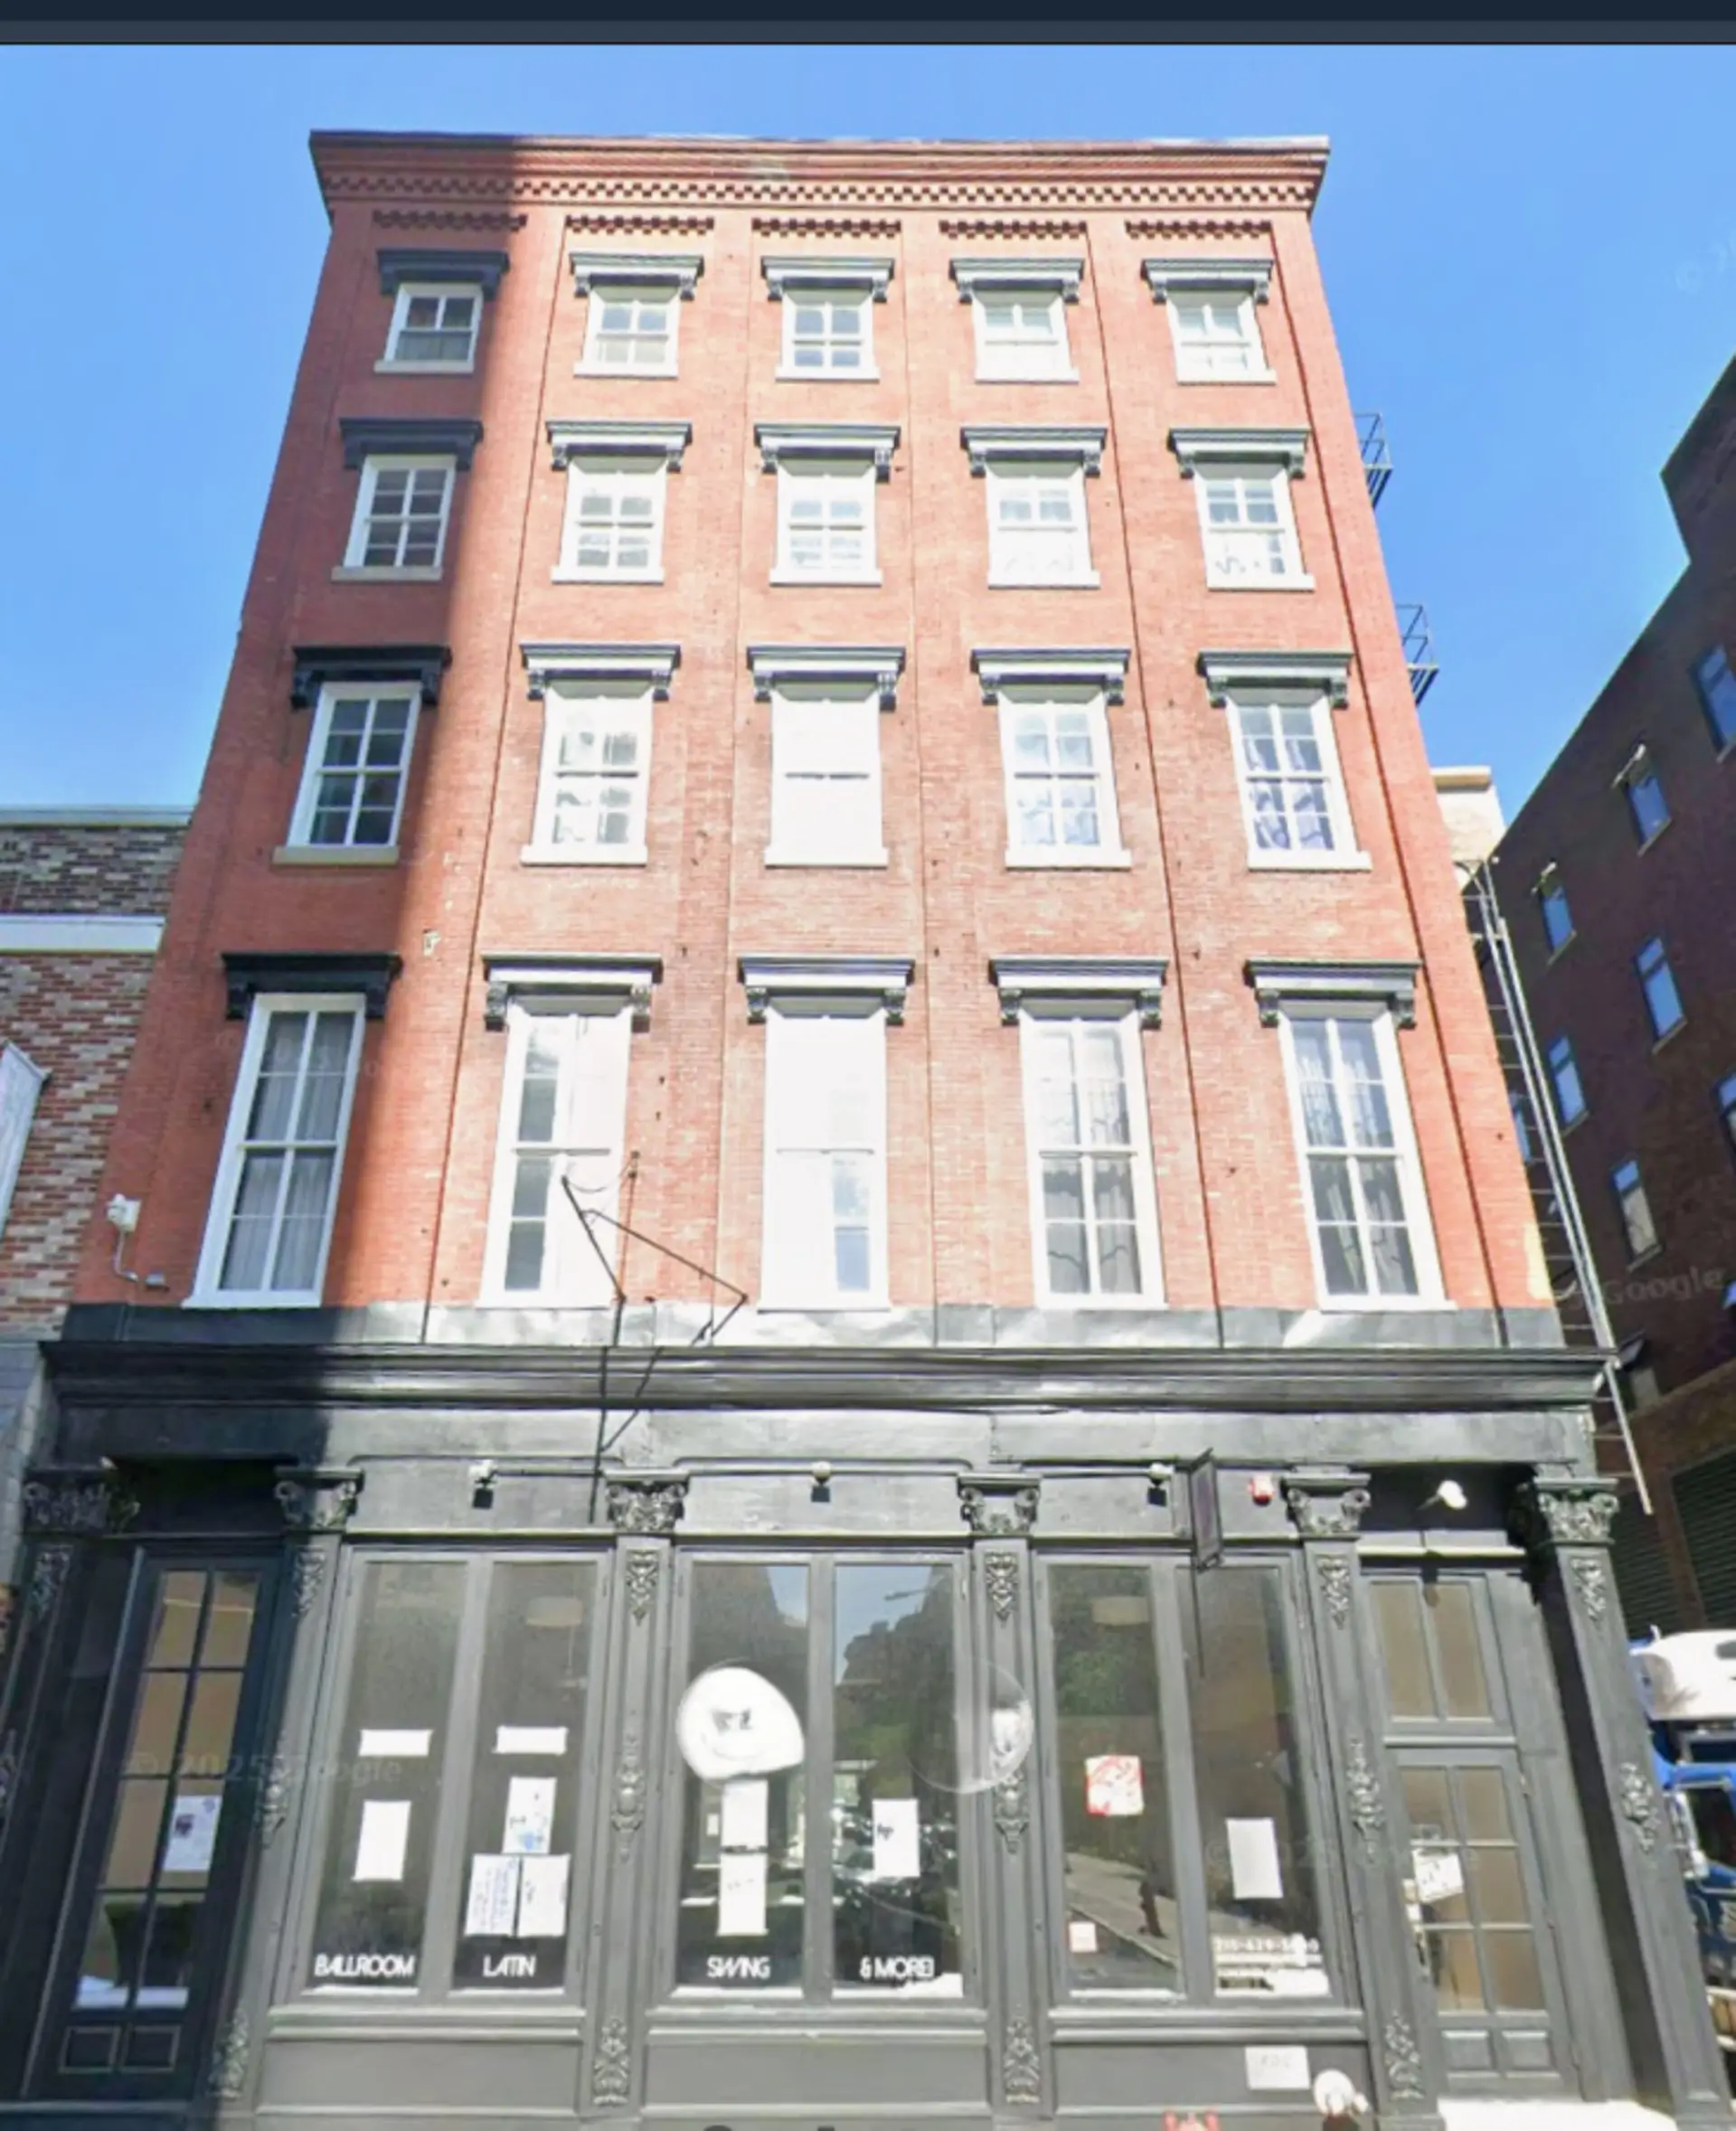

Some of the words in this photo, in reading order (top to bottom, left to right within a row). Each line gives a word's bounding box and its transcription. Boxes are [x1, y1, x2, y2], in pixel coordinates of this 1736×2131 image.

[315, 1953, 417, 1978] BALLROOM
[483, 1954, 537, 1978] LATIN
[707, 1954, 771, 1979] SWING
[860, 1955, 872, 1979] &
